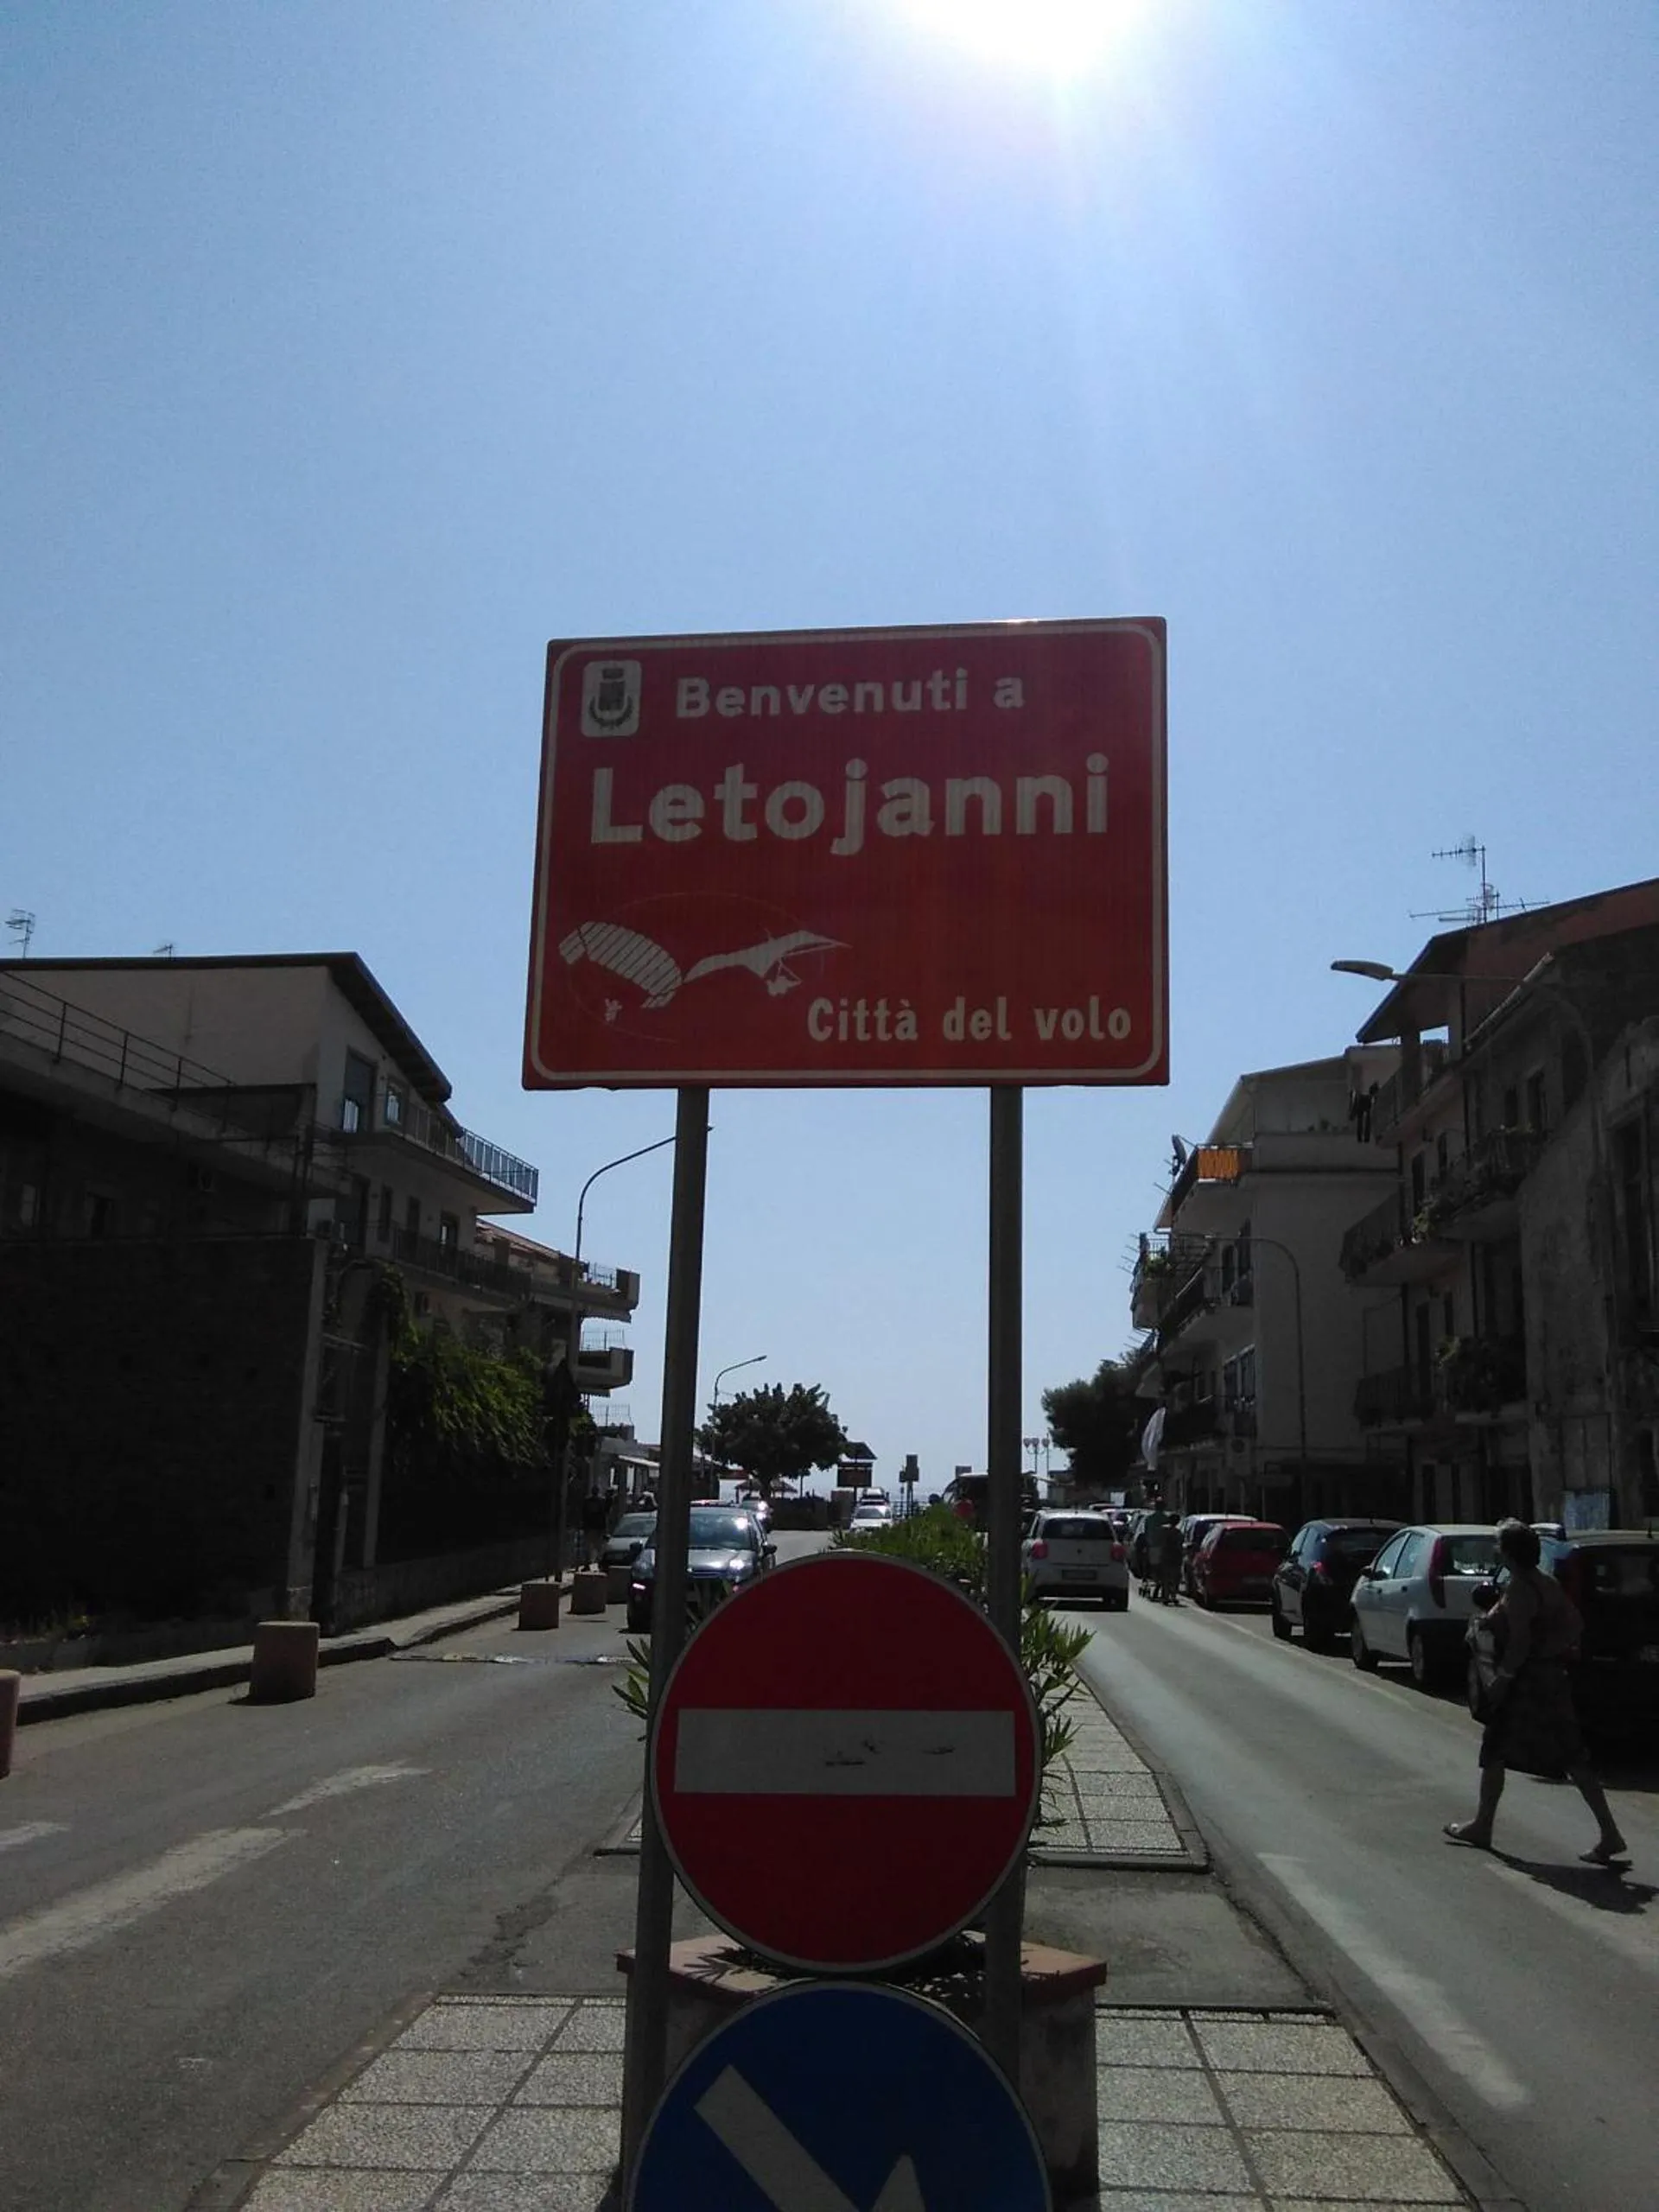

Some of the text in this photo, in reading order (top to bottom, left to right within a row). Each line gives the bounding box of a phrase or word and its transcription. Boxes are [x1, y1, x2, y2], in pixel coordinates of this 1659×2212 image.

[677, 669, 1025, 718] Benvenuti a
[591, 753, 1109, 855] Letojanni
[808, 995, 1132, 1043] Città del volo
